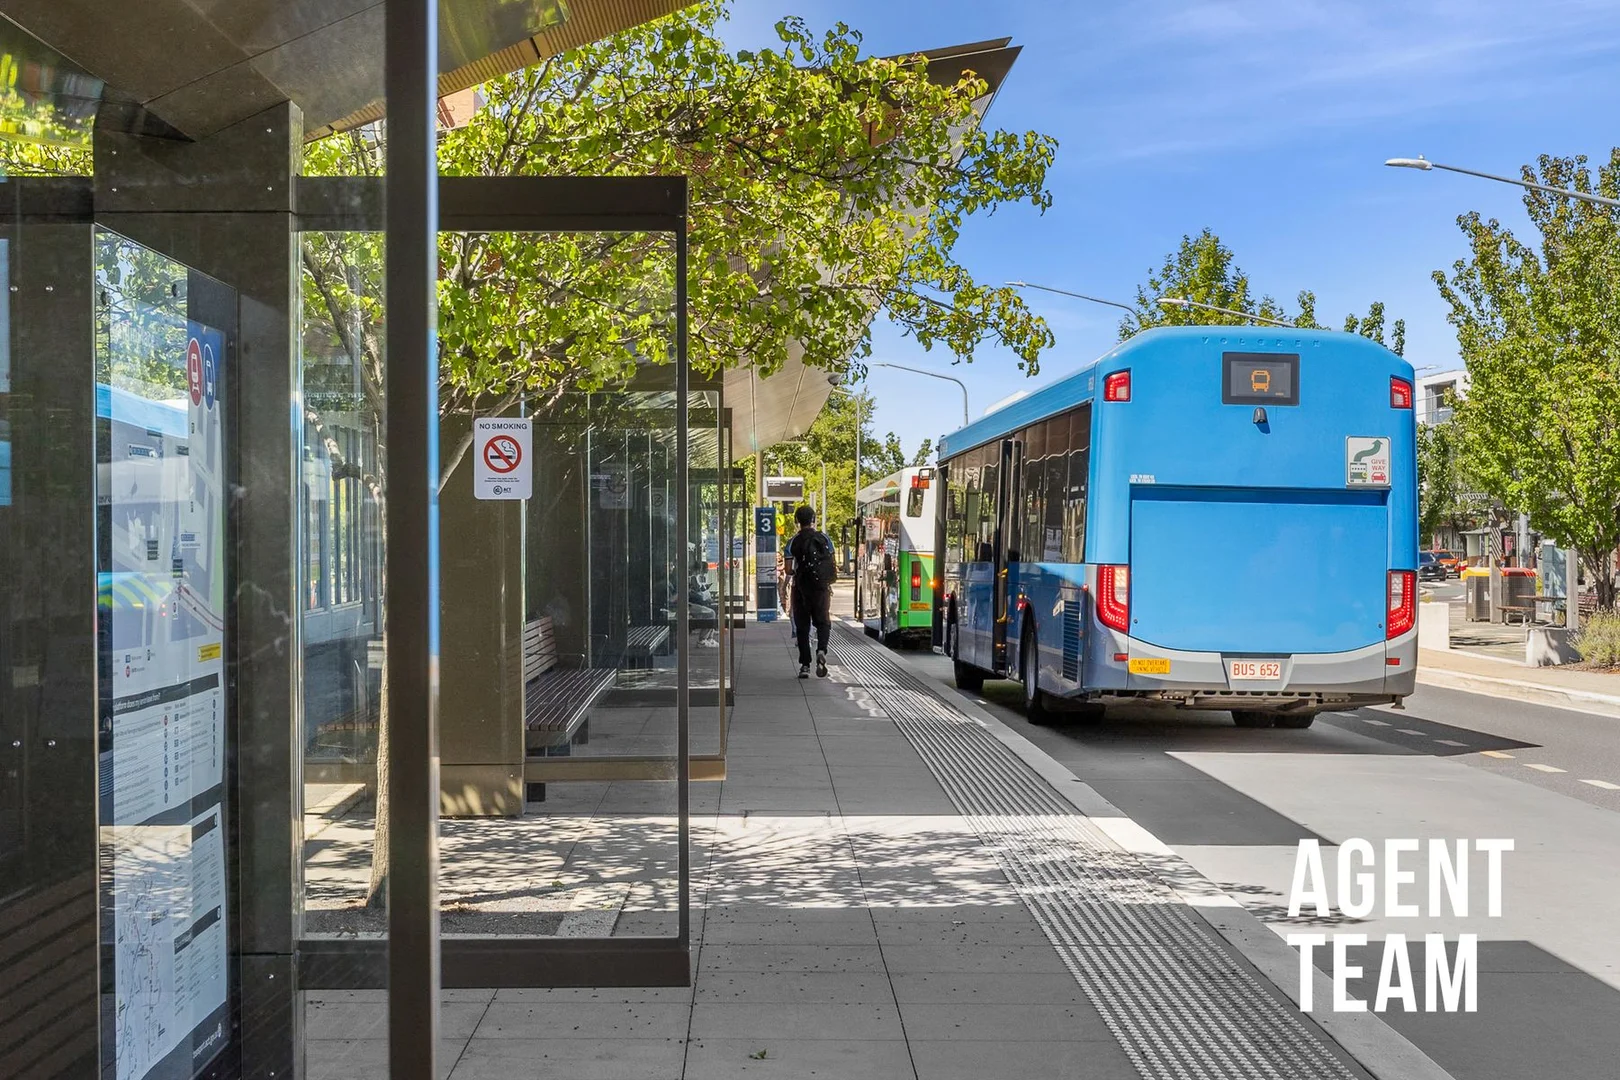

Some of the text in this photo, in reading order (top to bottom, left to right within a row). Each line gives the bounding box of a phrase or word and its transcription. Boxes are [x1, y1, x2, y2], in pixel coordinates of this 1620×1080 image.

[761, 518, 771, 532] 3
[1233, 663, 1279, 677] BUS 652
